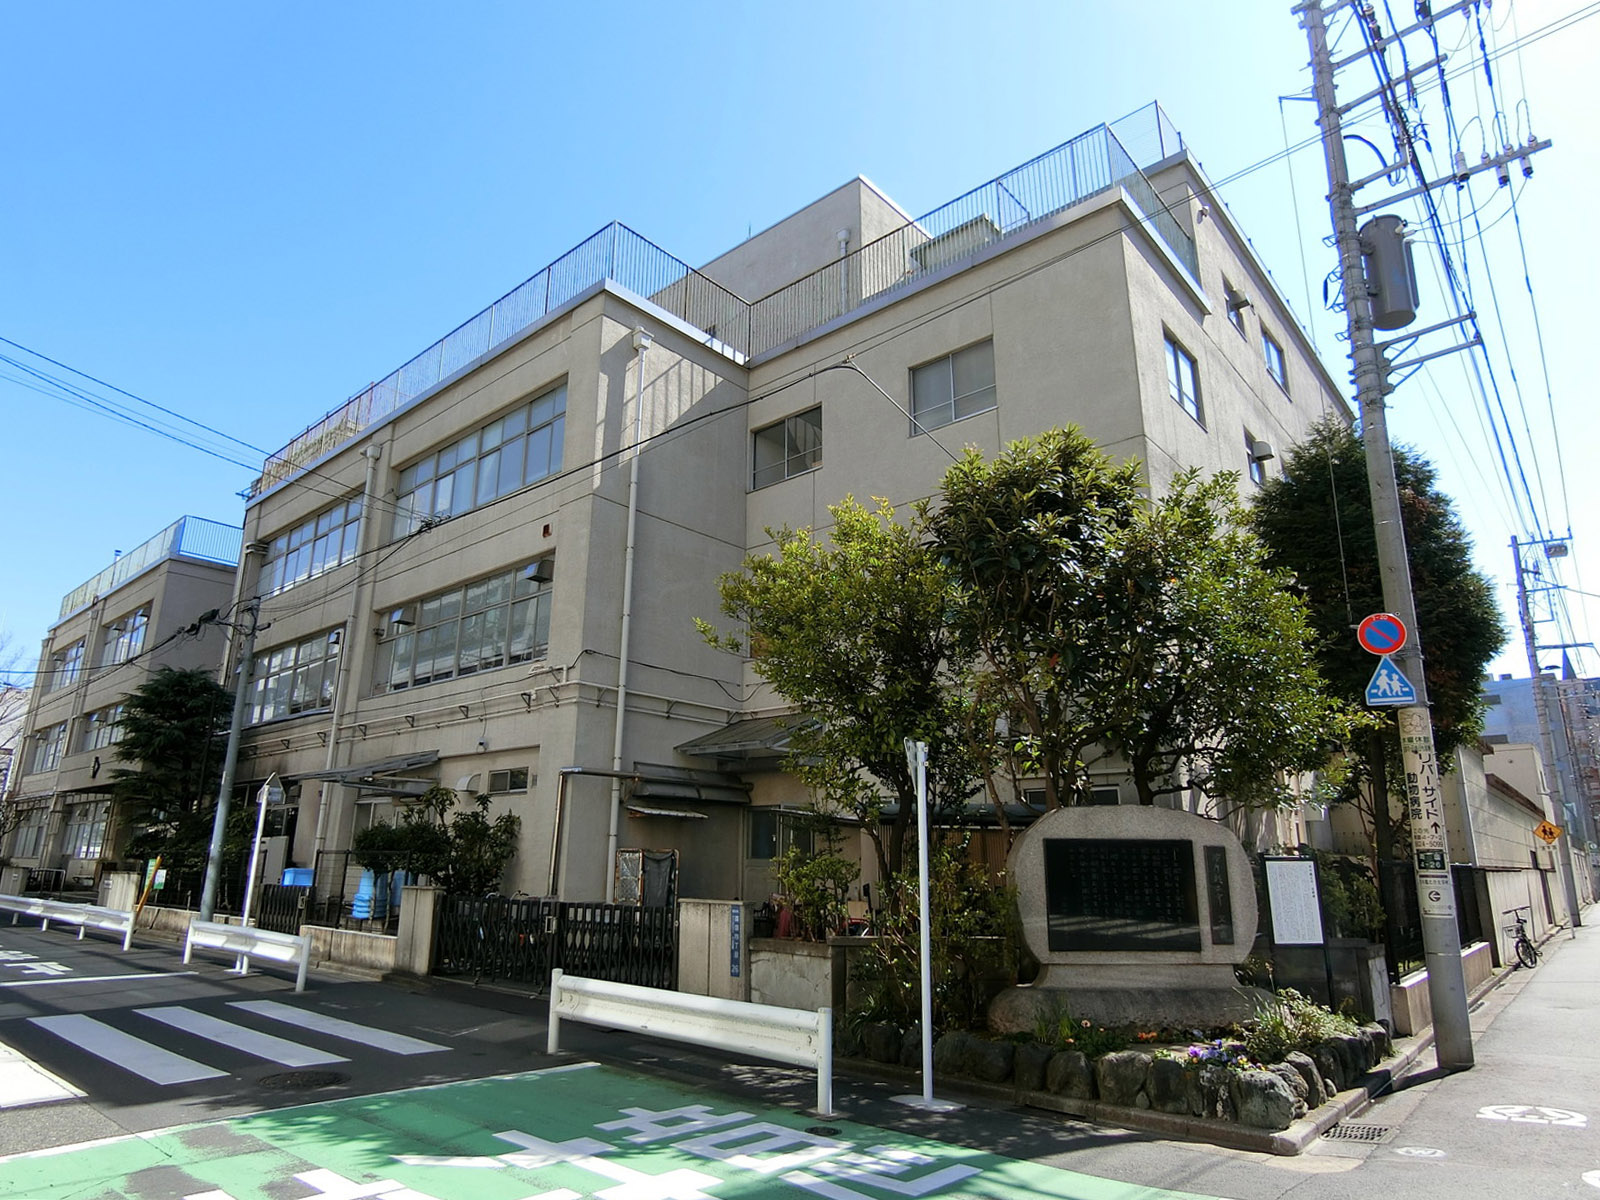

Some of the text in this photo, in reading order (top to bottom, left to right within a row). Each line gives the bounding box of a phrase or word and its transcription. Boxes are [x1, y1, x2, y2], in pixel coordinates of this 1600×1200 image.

[1406, 772, 1423, 820] 動物病院
[1418, 753, 1439, 819] リバーサイド
